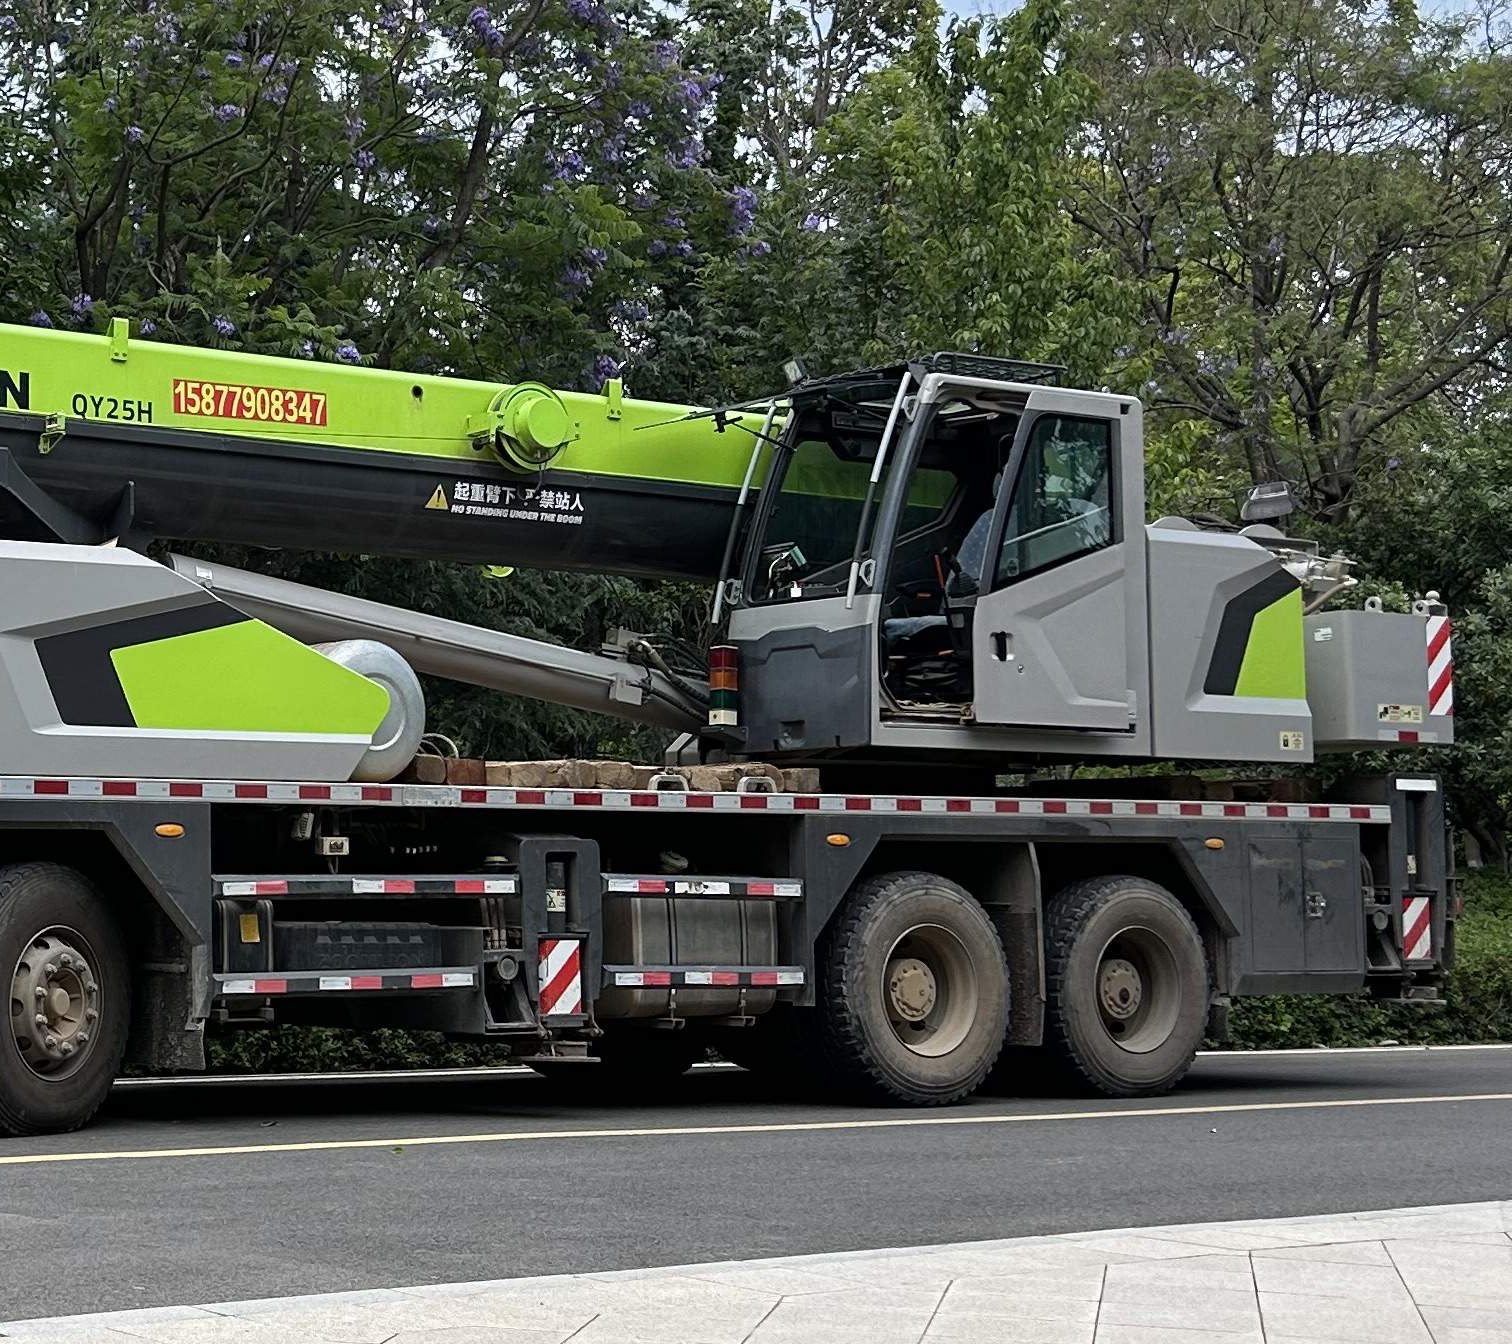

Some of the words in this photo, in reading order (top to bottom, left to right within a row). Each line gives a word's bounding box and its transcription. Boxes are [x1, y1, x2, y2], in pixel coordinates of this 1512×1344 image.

[71, 393, 153, 424] QY25H
[174, 380, 327, 425] 15877908347
[450, 504, 465, 514] NO
[465, 505, 509, 518] STANDING
[509, 509, 539, 521] UNDER
[540, 513, 556, 522] THE
[556, 514, 583, 525] BOOM
